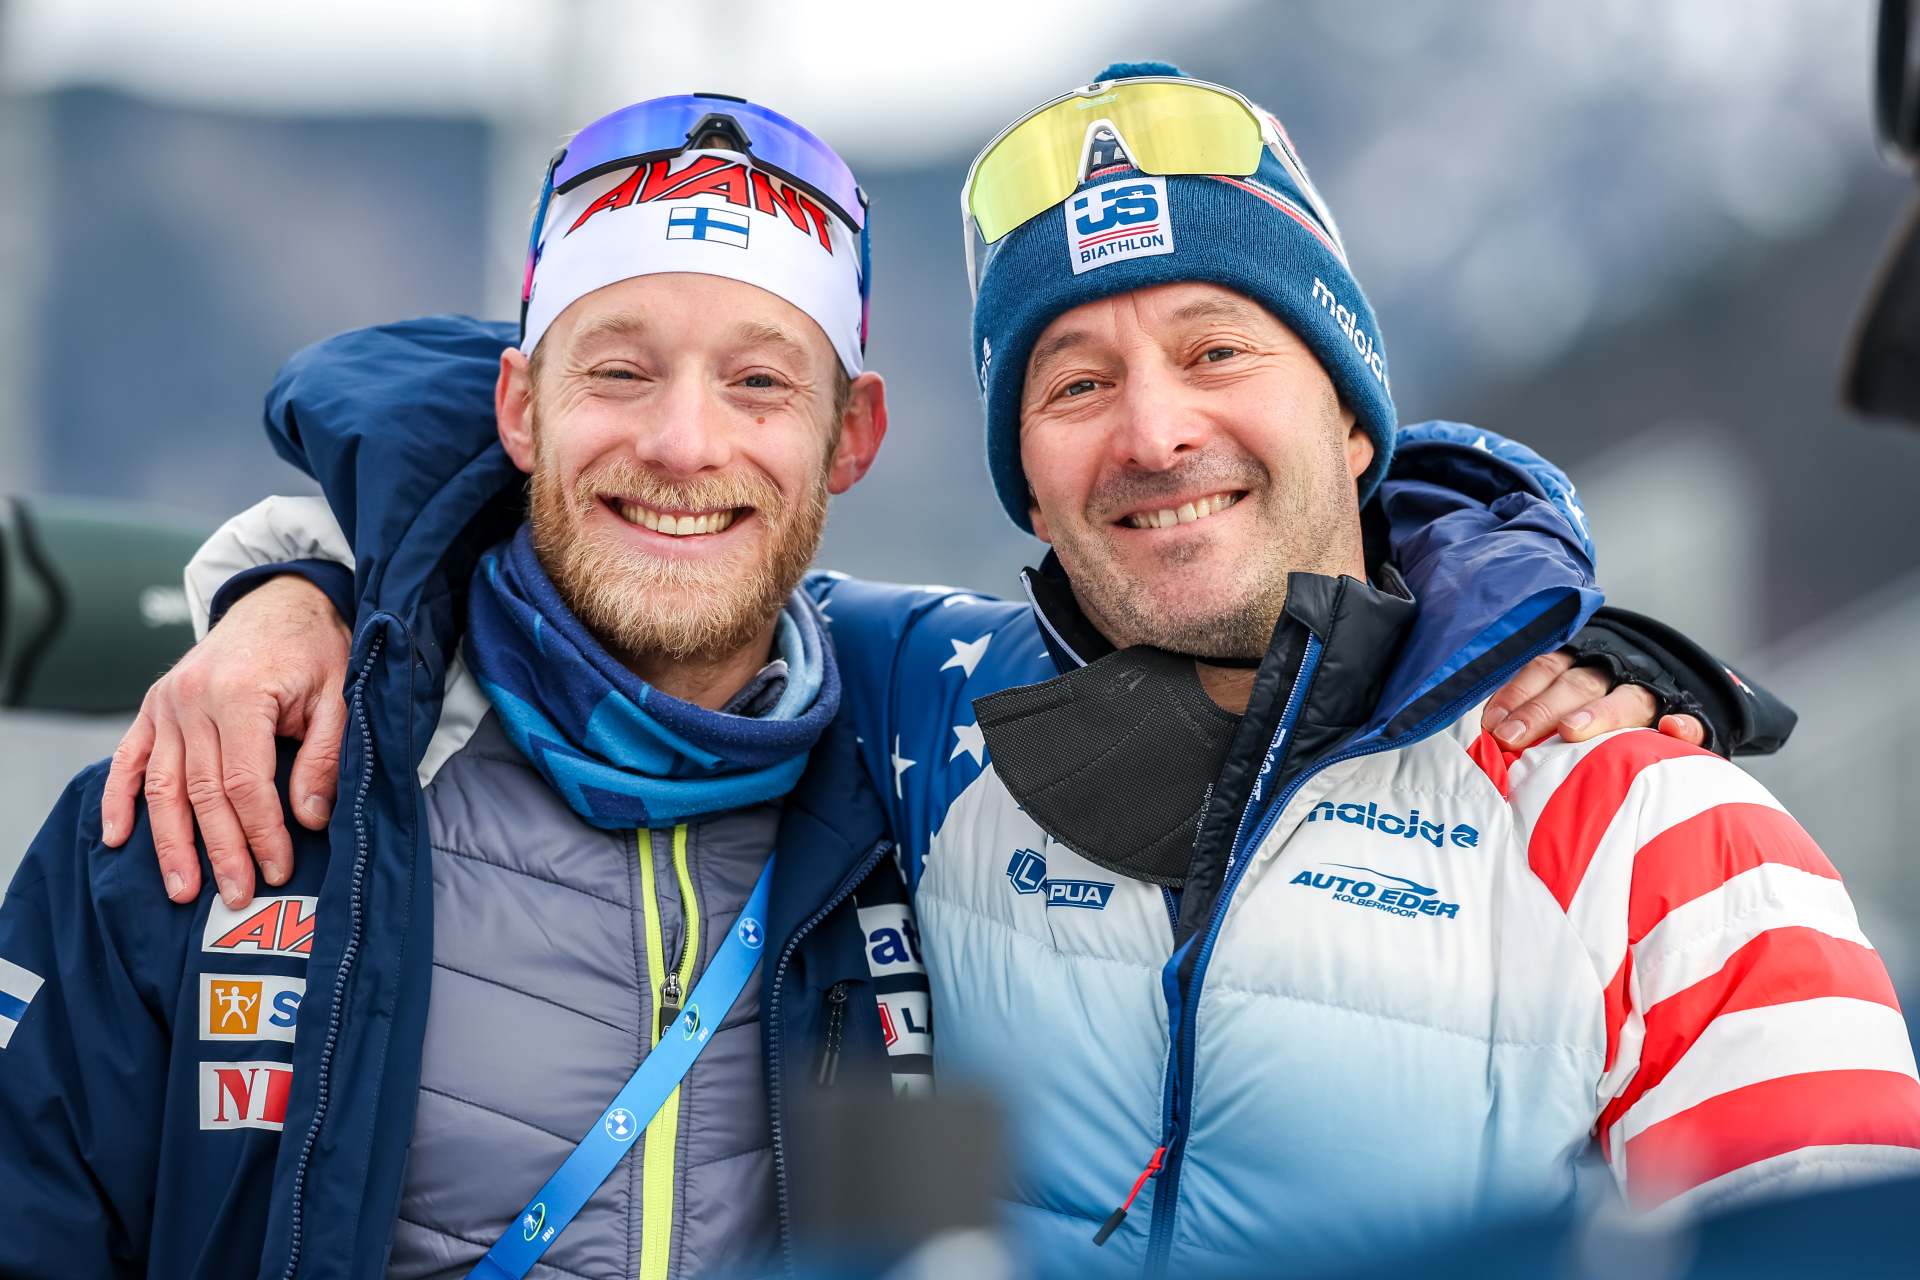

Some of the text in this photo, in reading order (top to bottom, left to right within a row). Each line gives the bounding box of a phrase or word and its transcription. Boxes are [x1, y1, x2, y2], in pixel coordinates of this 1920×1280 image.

[563, 154, 833, 256] AVANT
[1074, 184, 1159, 235] US
[1080, 234, 1165, 264] BIATHLON
[1312, 277, 1383, 384] maloja
[1289, 871, 1461, 919] AUTO EDER
[1332, 892, 1418, 919] KOLBERMOOR
